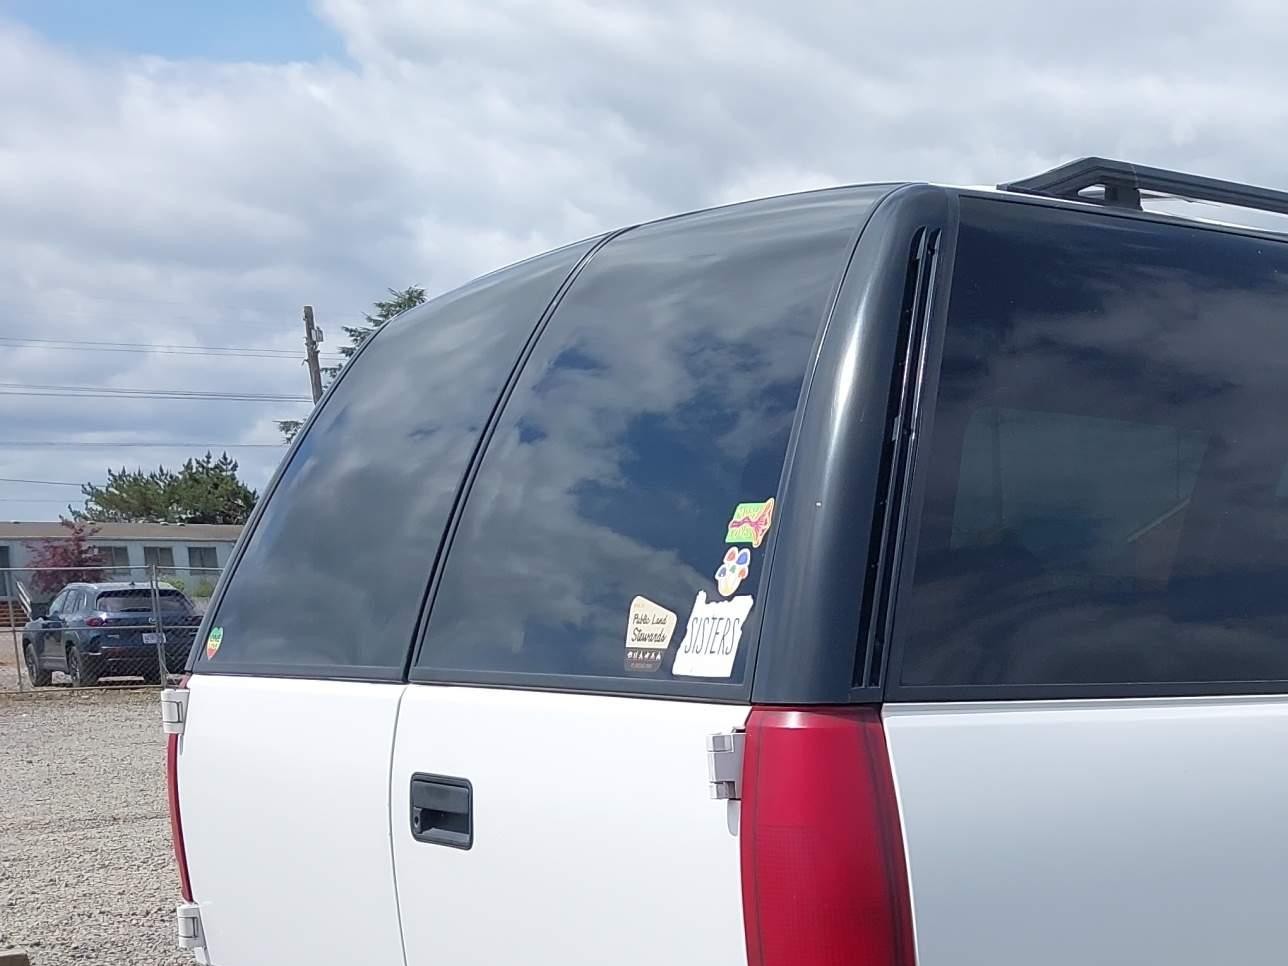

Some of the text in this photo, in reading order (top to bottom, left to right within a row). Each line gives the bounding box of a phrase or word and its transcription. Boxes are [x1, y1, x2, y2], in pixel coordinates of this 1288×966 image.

[633, 613, 668, 625] Public Land
[631, 627, 667, 642] Stewards
[685, 617, 740, 655] SISTERS
